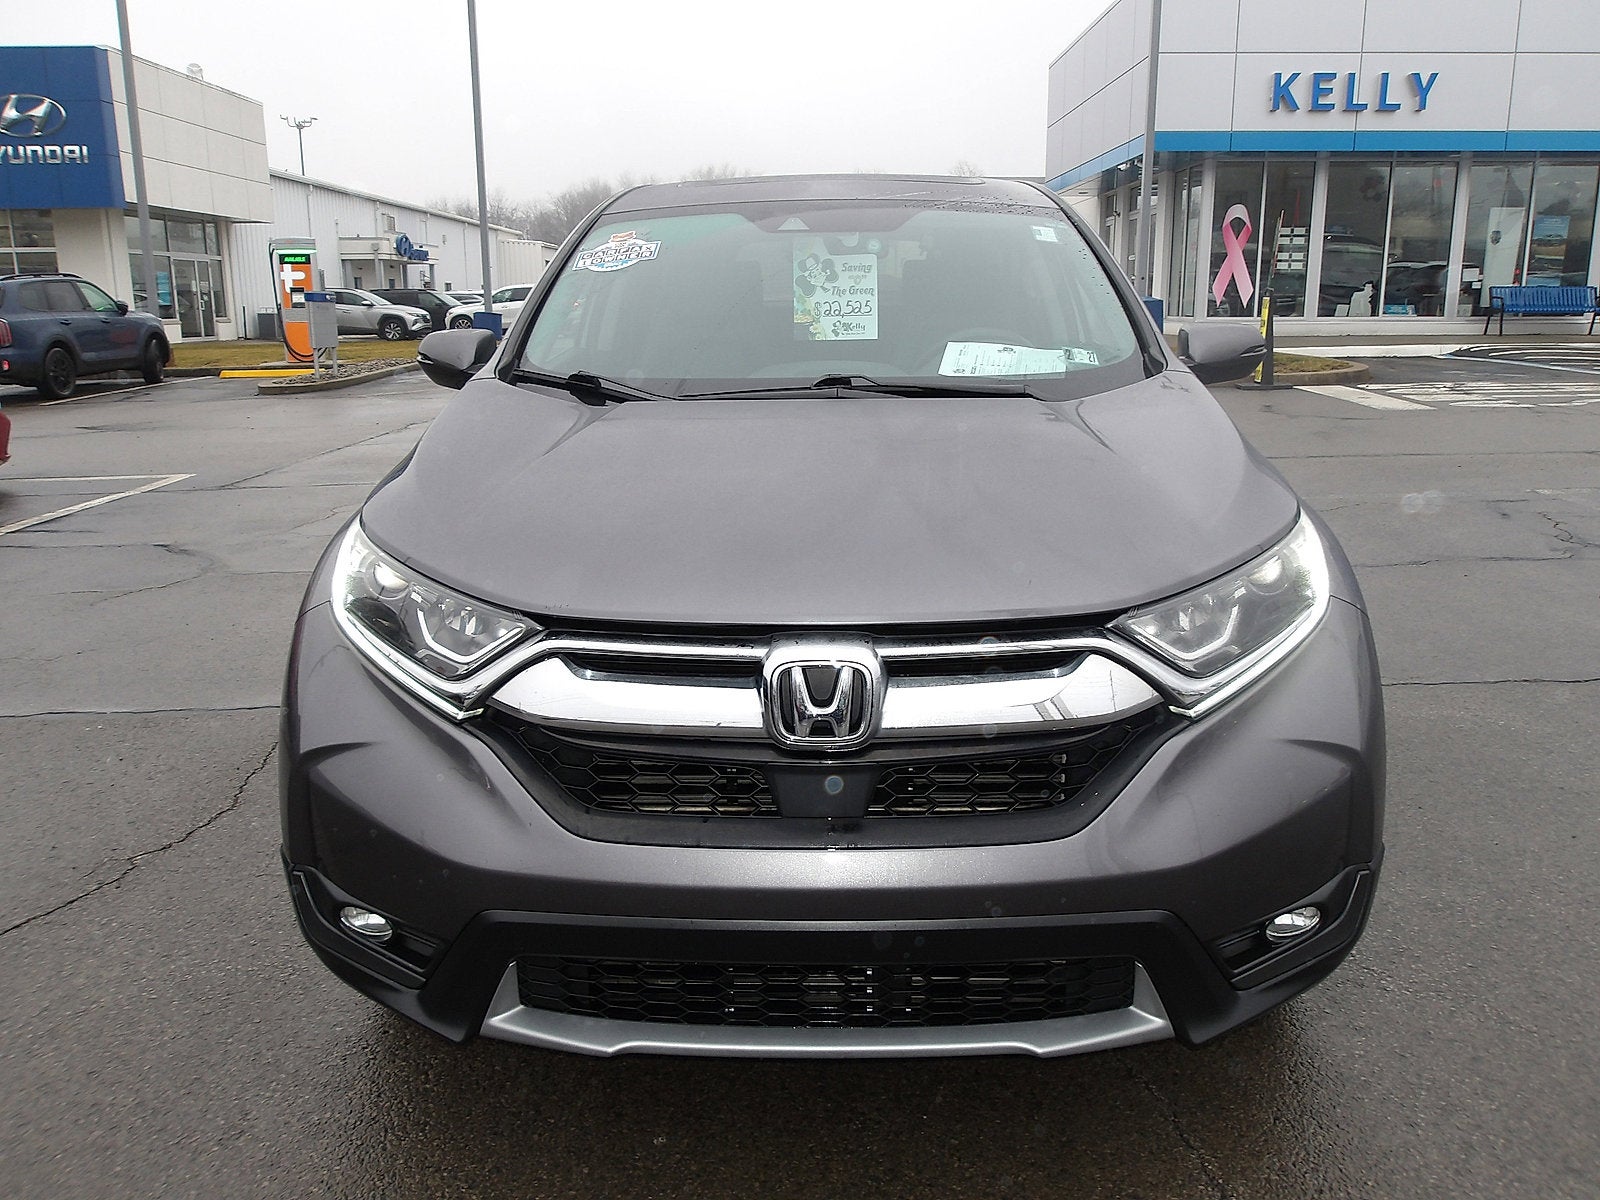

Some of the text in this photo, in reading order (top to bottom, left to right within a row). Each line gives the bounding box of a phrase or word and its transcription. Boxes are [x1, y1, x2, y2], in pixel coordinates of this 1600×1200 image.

[1271, 71, 1440, 112] KELLY
[581, 244, 653, 259] CARFAX
[841, 262, 873, 273] Saving
[831, 285, 875, 297] The Green
